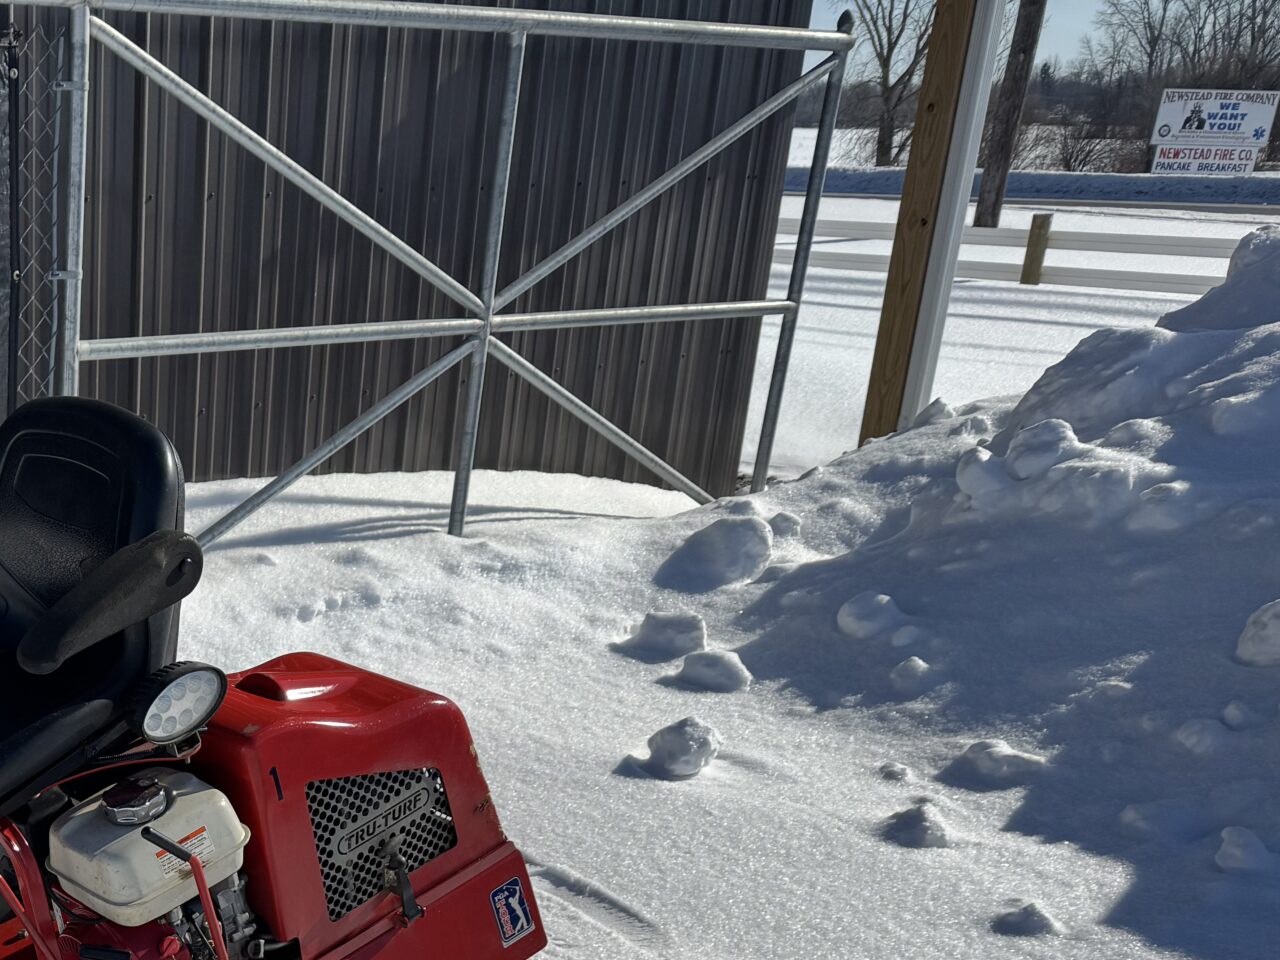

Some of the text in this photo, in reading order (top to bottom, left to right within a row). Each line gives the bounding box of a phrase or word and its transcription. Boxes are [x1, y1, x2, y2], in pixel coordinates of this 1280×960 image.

[1163, 91, 1277, 106] NEWSTEAD FIRE COMPANY
[1219, 102, 1241, 111] WE
[1206, 111, 1248, 121] WANT
[1207, 122, 1242, 131] YOU!
[1159, 147, 1253, 161] NEWSTEAD FIRE CO.
[1154, 161, 1249, 172] PANCAKE BREAKFAST
[344, 791, 425, 852] TRU-TURF
